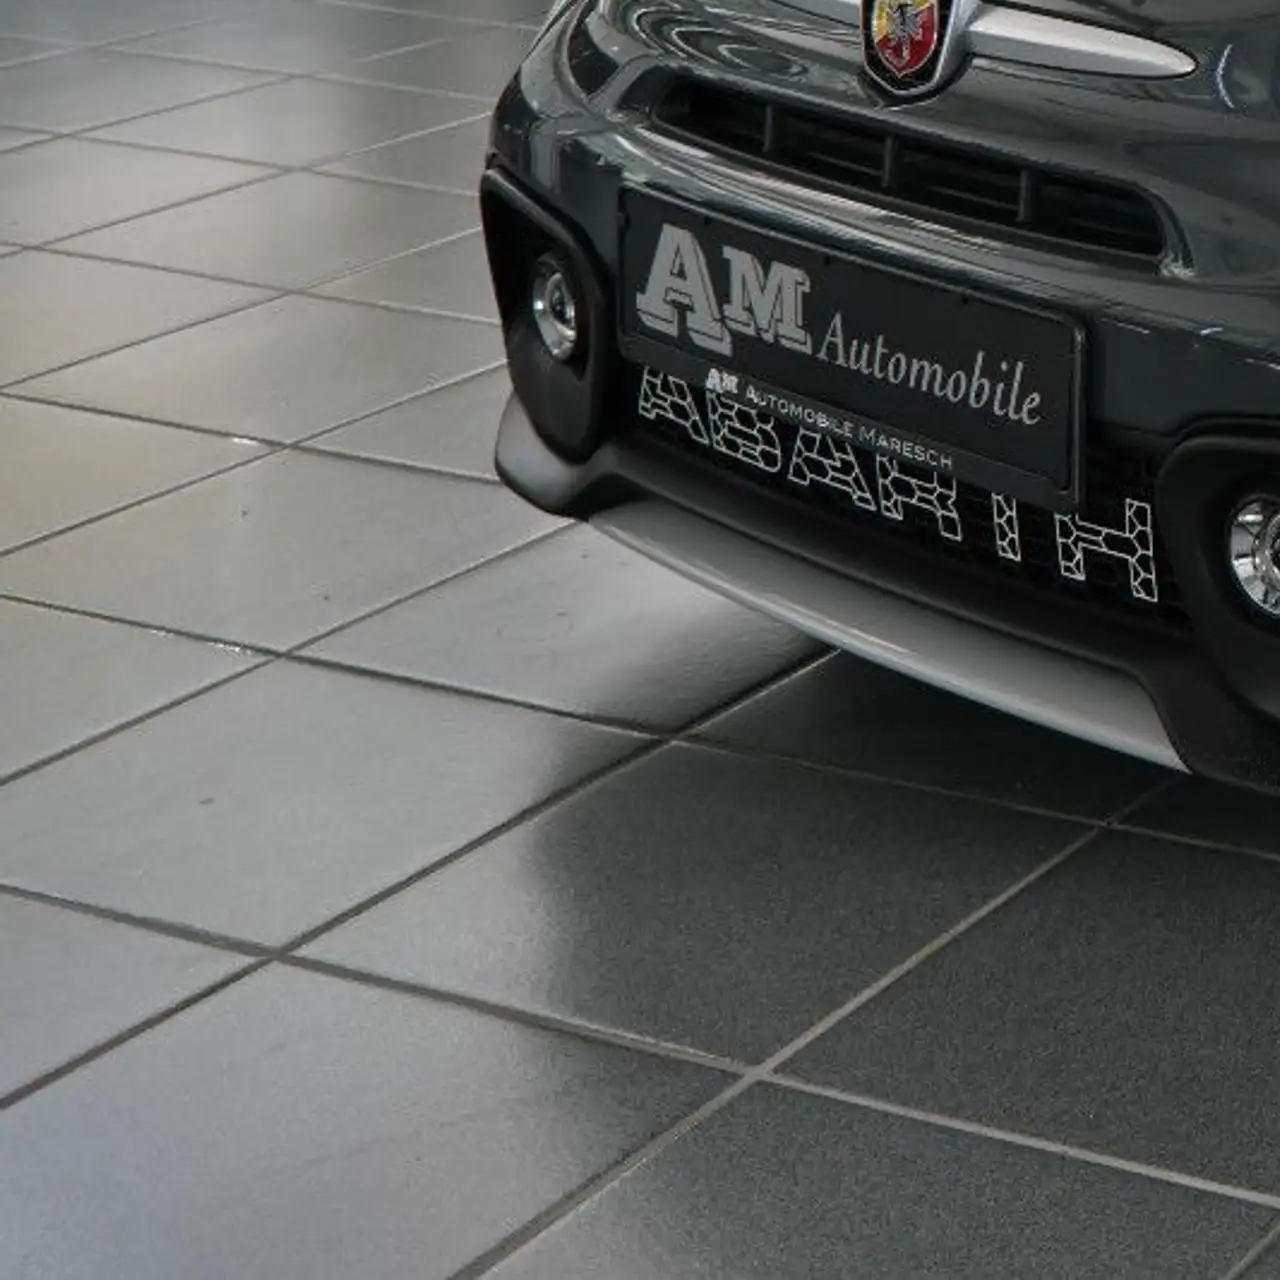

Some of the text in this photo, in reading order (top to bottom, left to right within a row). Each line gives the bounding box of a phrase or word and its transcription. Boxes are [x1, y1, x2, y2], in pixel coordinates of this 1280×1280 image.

[636, 222, 1042, 426] AM Automobile
[745, 384, 854, 439] AUTOMOBILE
[859, 425, 952, 470] MARESCH
